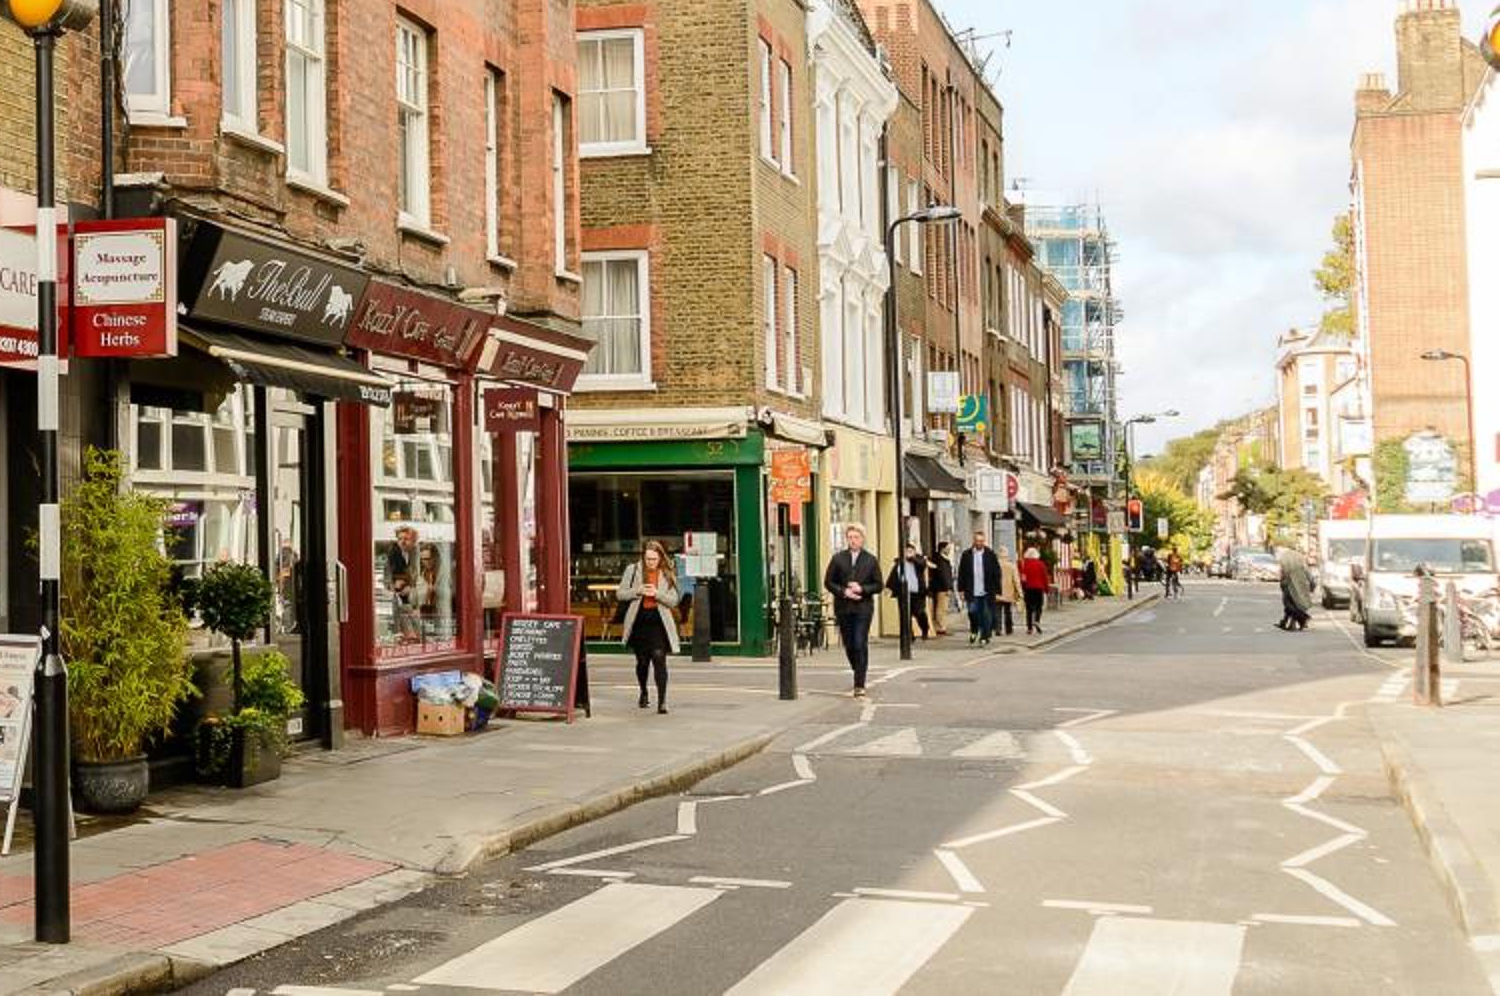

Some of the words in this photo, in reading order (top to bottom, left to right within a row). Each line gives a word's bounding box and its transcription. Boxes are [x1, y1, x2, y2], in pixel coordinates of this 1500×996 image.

[97, 253, 146, 266] Massage
[83, 272, 158, 286] Acupuncture
[92, 312, 147, 327] Chinese
[100, 332, 140, 347] Herbs
[707, 442, 724, 456] 52
